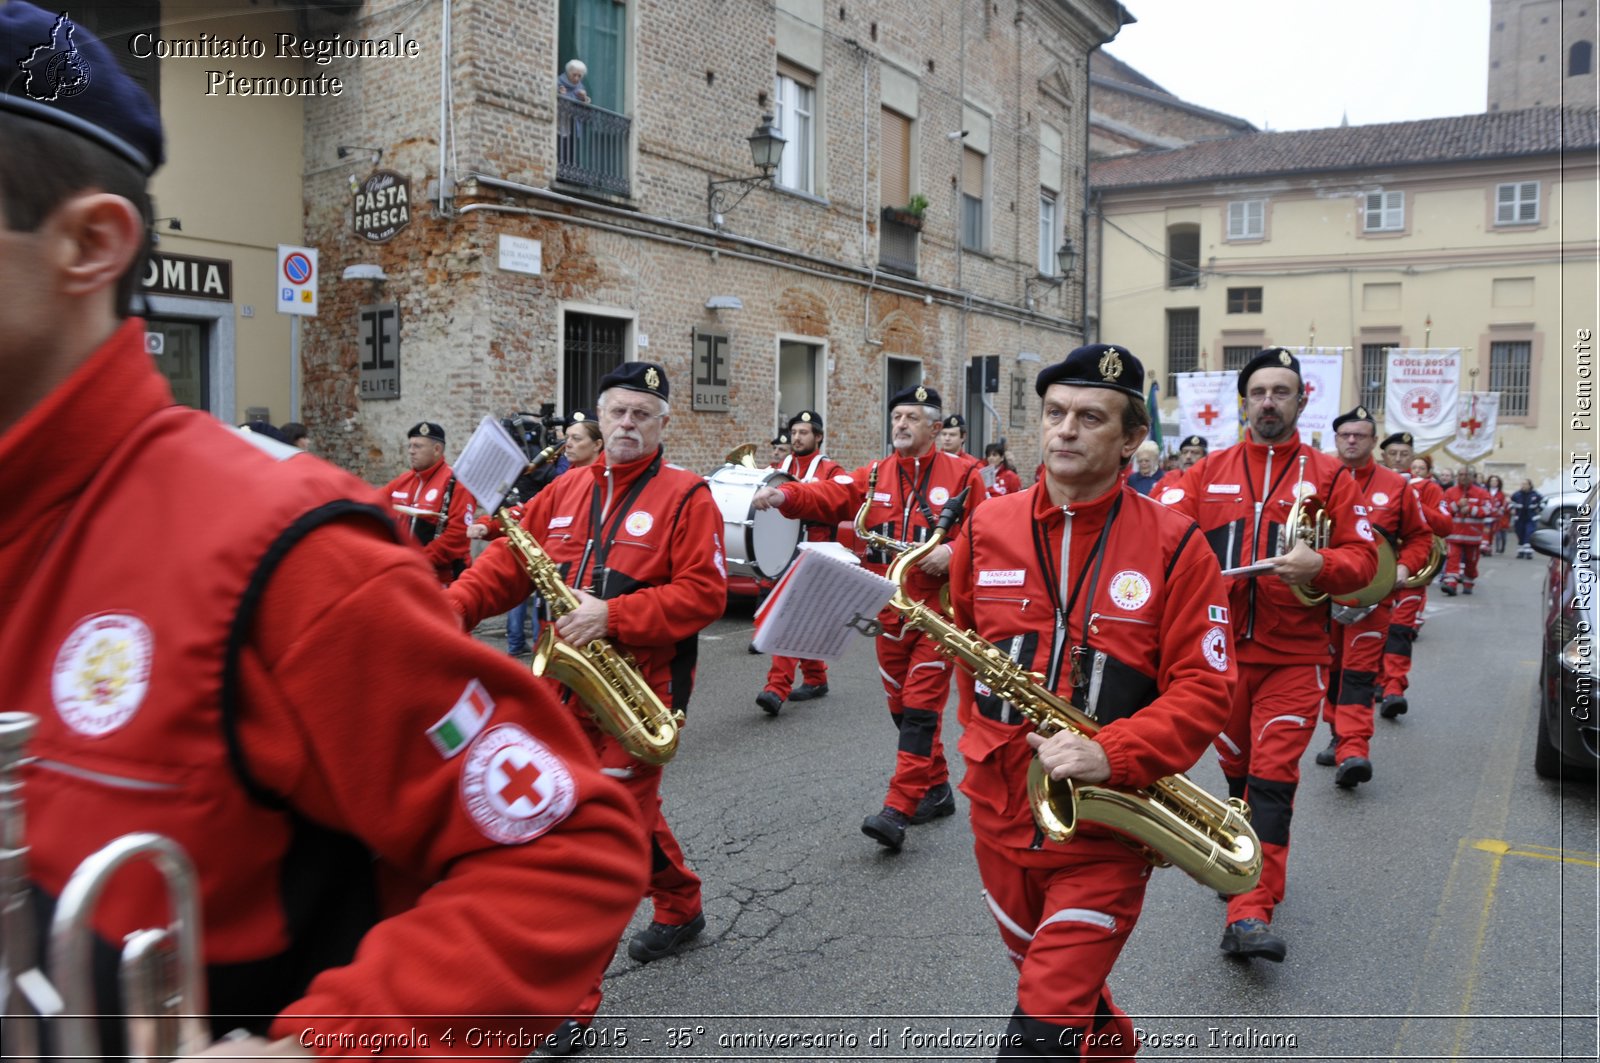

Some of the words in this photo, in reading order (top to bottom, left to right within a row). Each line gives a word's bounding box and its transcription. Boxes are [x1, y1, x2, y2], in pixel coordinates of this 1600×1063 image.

[356, 184, 408, 213] PASTA
[356, 206, 408, 231] FRESCA
[1424, 359, 1456, 367] ROSSA
[1402, 368, 1444, 376] ITALIANA
[362, 378, 395, 392] ELITE
[696, 393, 728, 405] ELITE
